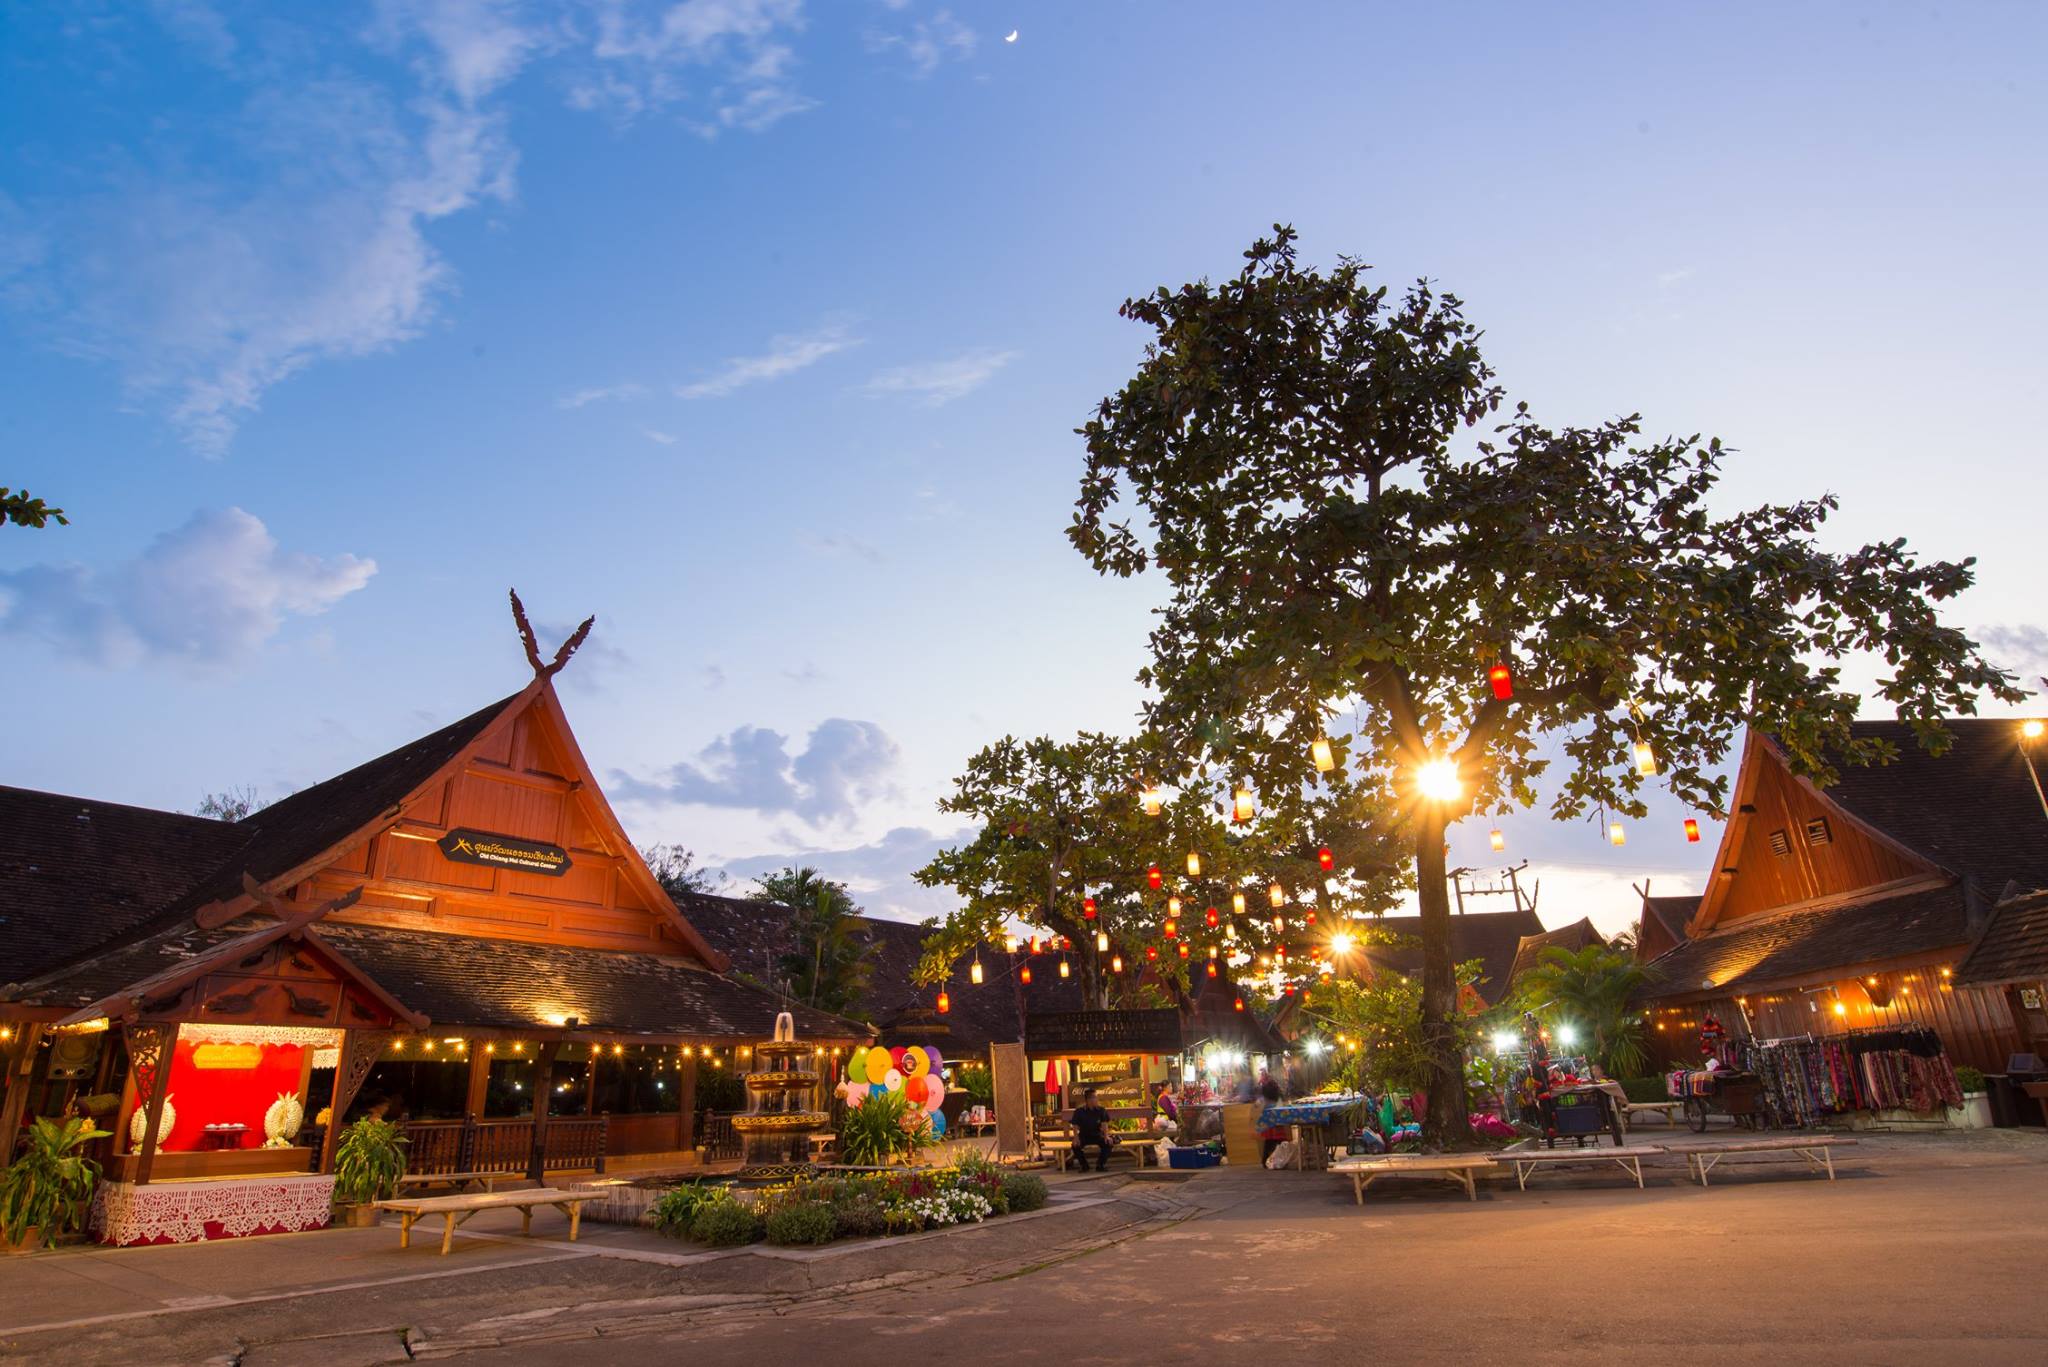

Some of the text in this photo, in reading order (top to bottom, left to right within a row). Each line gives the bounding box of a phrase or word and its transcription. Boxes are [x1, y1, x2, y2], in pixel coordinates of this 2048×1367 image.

[489, 853, 508, 863] Chiang
[519, 858, 540, 867] Cultural
[1081, 1062, 1116, 1073] Welcome
